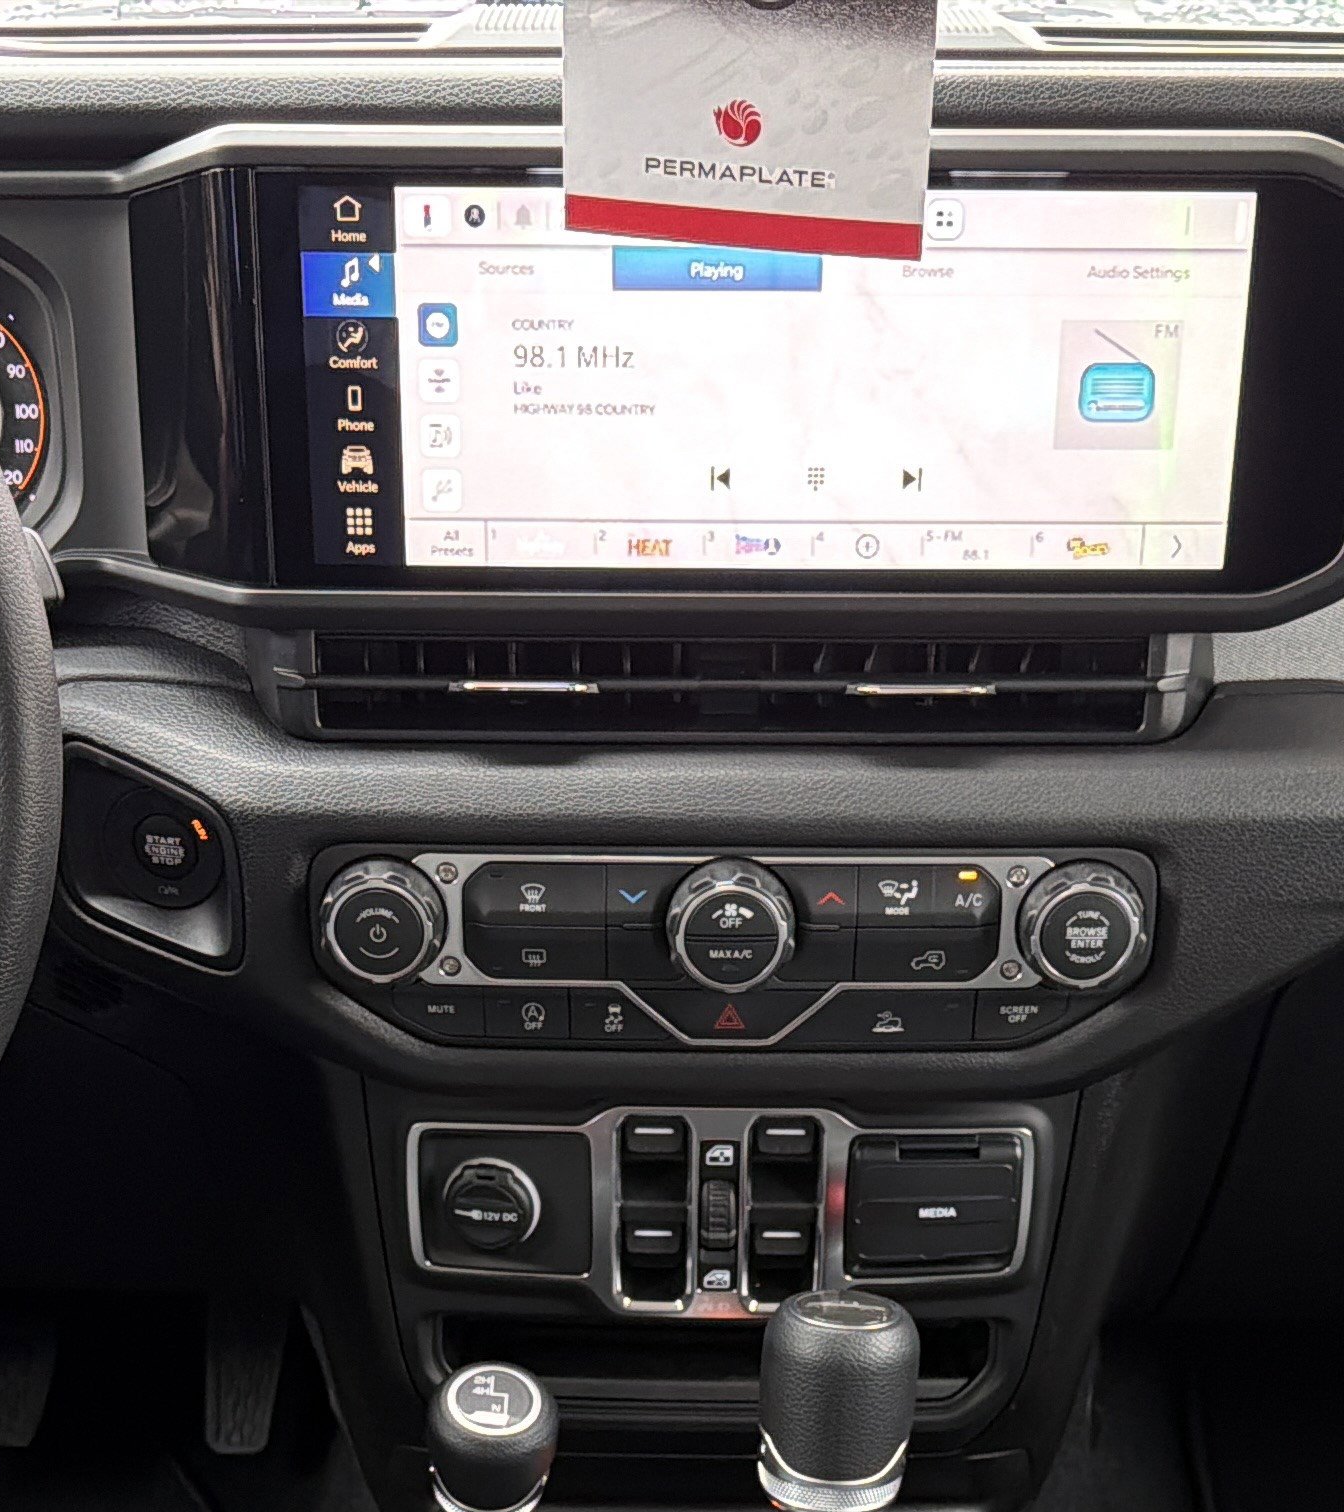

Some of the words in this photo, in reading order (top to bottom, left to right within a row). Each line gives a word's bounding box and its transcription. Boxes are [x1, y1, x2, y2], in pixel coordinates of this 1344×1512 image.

[645, 156, 827, 188] PERMAPLATE
[331, 229, 367, 243] Home
[478, 261, 535, 276] Sources
[690, 261, 744, 281] Playing
[902, 265, 954, 278] Browse
[1087, 265, 1129, 279] Audio
[1133, 265, 1191, 282] Settings
[511, 318, 575, 331] COUNTRY
[1154, 324, 1180, 339] FM
[329, 356, 378, 370] Comfort
[513, 344, 566, 369] 98.1
[577, 345, 635, 369] MHz
[6, 364, 26, 379] 90
[15, 404, 39, 419] 100
[595, 403, 656, 416] COUNTRY
[337, 418, 375, 432] Phone
[15, 439, 34, 454] 110
[337, 480, 379, 494] Vehicle
[346, 541, 376, 556] Apps
[628, 538, 673, 557] HEAT
[955, 892, 983, 908] A/C
[519, 904, 547, 913] FRONT
[885, 906, 910, 916] MODE
[719, 917, 743, 929] OFF
[1065, 926, 1108, 937] BROWSE
[1070, 939, 1104, 949] ENTER
[709, 949, 733, 959] MAX
[733, 949, 753, 959] A/C
[427, 1004, 456, 1015] MUTE
[999, 1005, 1039, 1015] SCREEN
[524, 1021, 544, 1031] OFF
[1007, 1014, 1027, 1024] OFF
[604, 1024, 624, 1033] OFF
[918, 1206, 957, 1218] MEDIA
